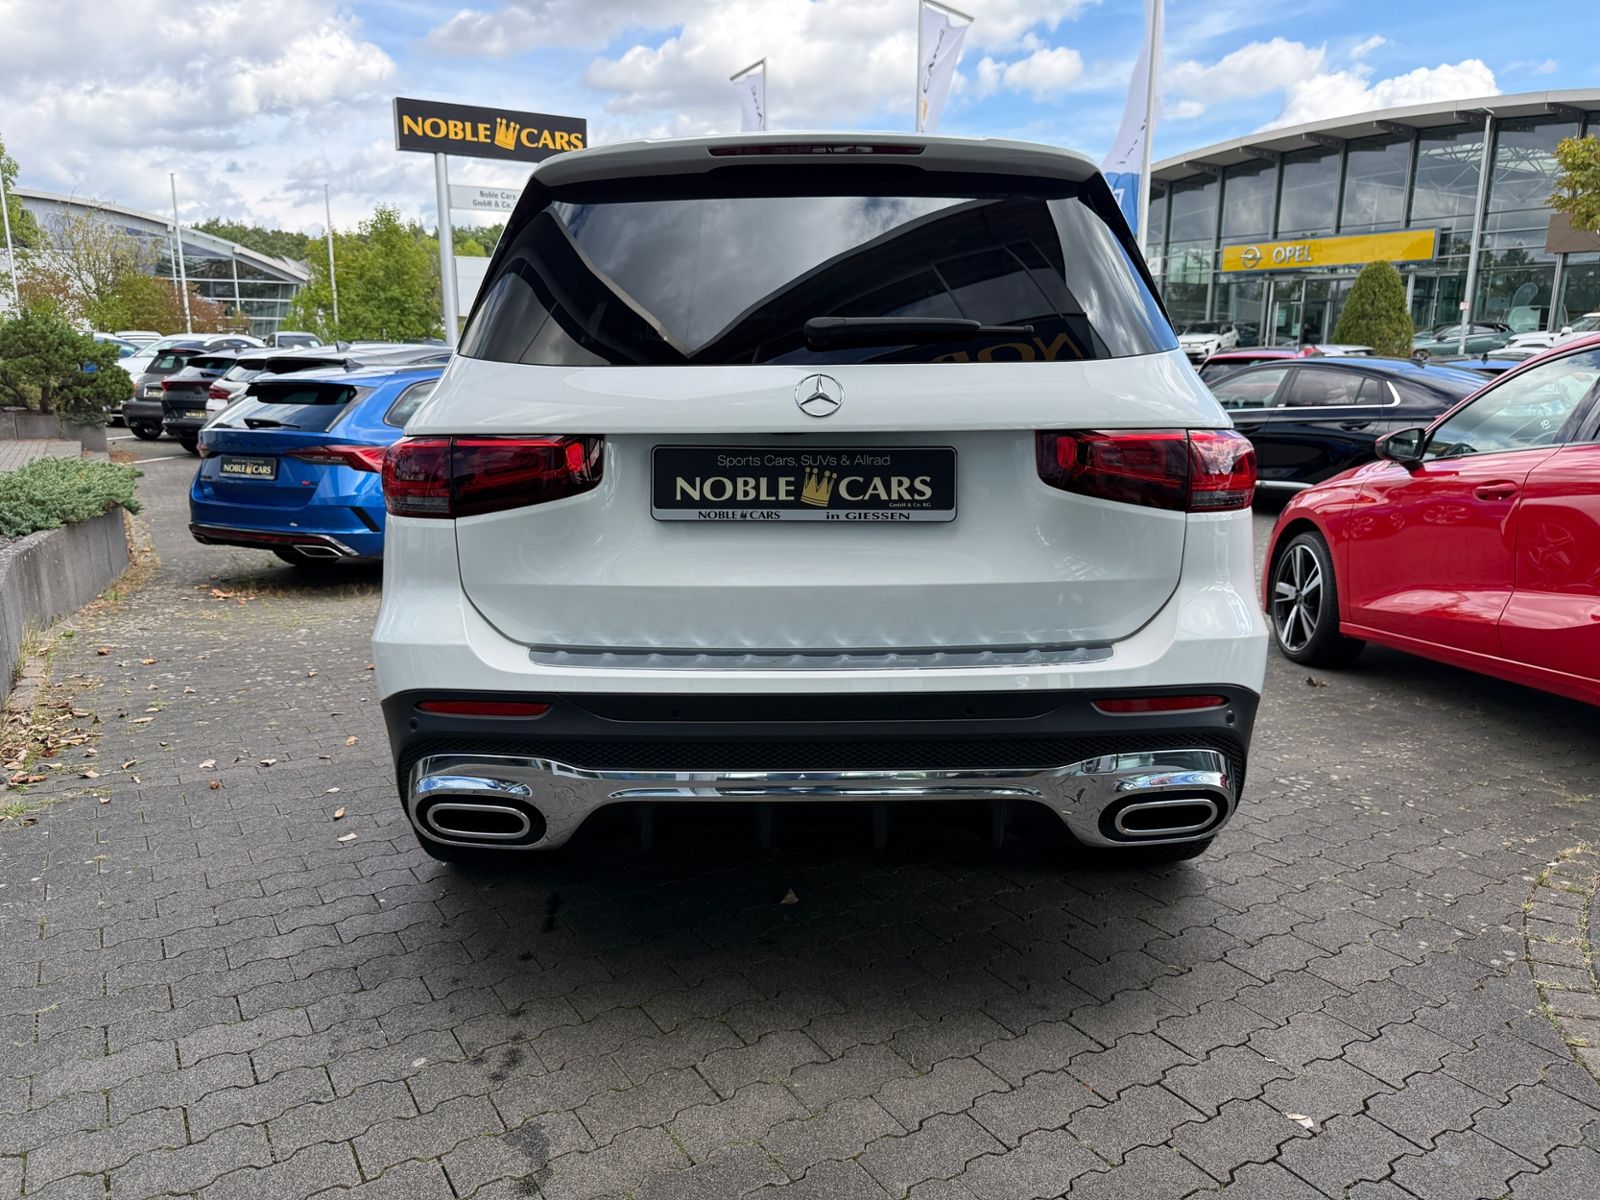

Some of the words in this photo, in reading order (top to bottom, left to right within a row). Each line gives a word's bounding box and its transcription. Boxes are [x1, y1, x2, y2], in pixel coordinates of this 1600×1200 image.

[402, 115, 491, 143] NOBLE
[520, 127, 584, 151] CARS
[479, 190, 499, 199] Noble
[1272, 246, 1312, 264] OPEL
[717, 455, 761, 468] Sports
[764, 455, 798, 468] Cars,
[800, 455, 838, 466] SUVs
[840, 455, 852, 466] &
[854, 454, 891, 466] Allrad
[223, 463, 245, 473] NOBLE
[252, 465, 272, 474] CARS
[675, 476, 795, 501] NOBLE
[838, 475, 933, 501] CARS
[698, 511, 738, 520] NOBLE
[749, 511, 781, 520] CARS
[826, 511, 840, 520] in
[845, 511, 910, 520] GIESSEN
